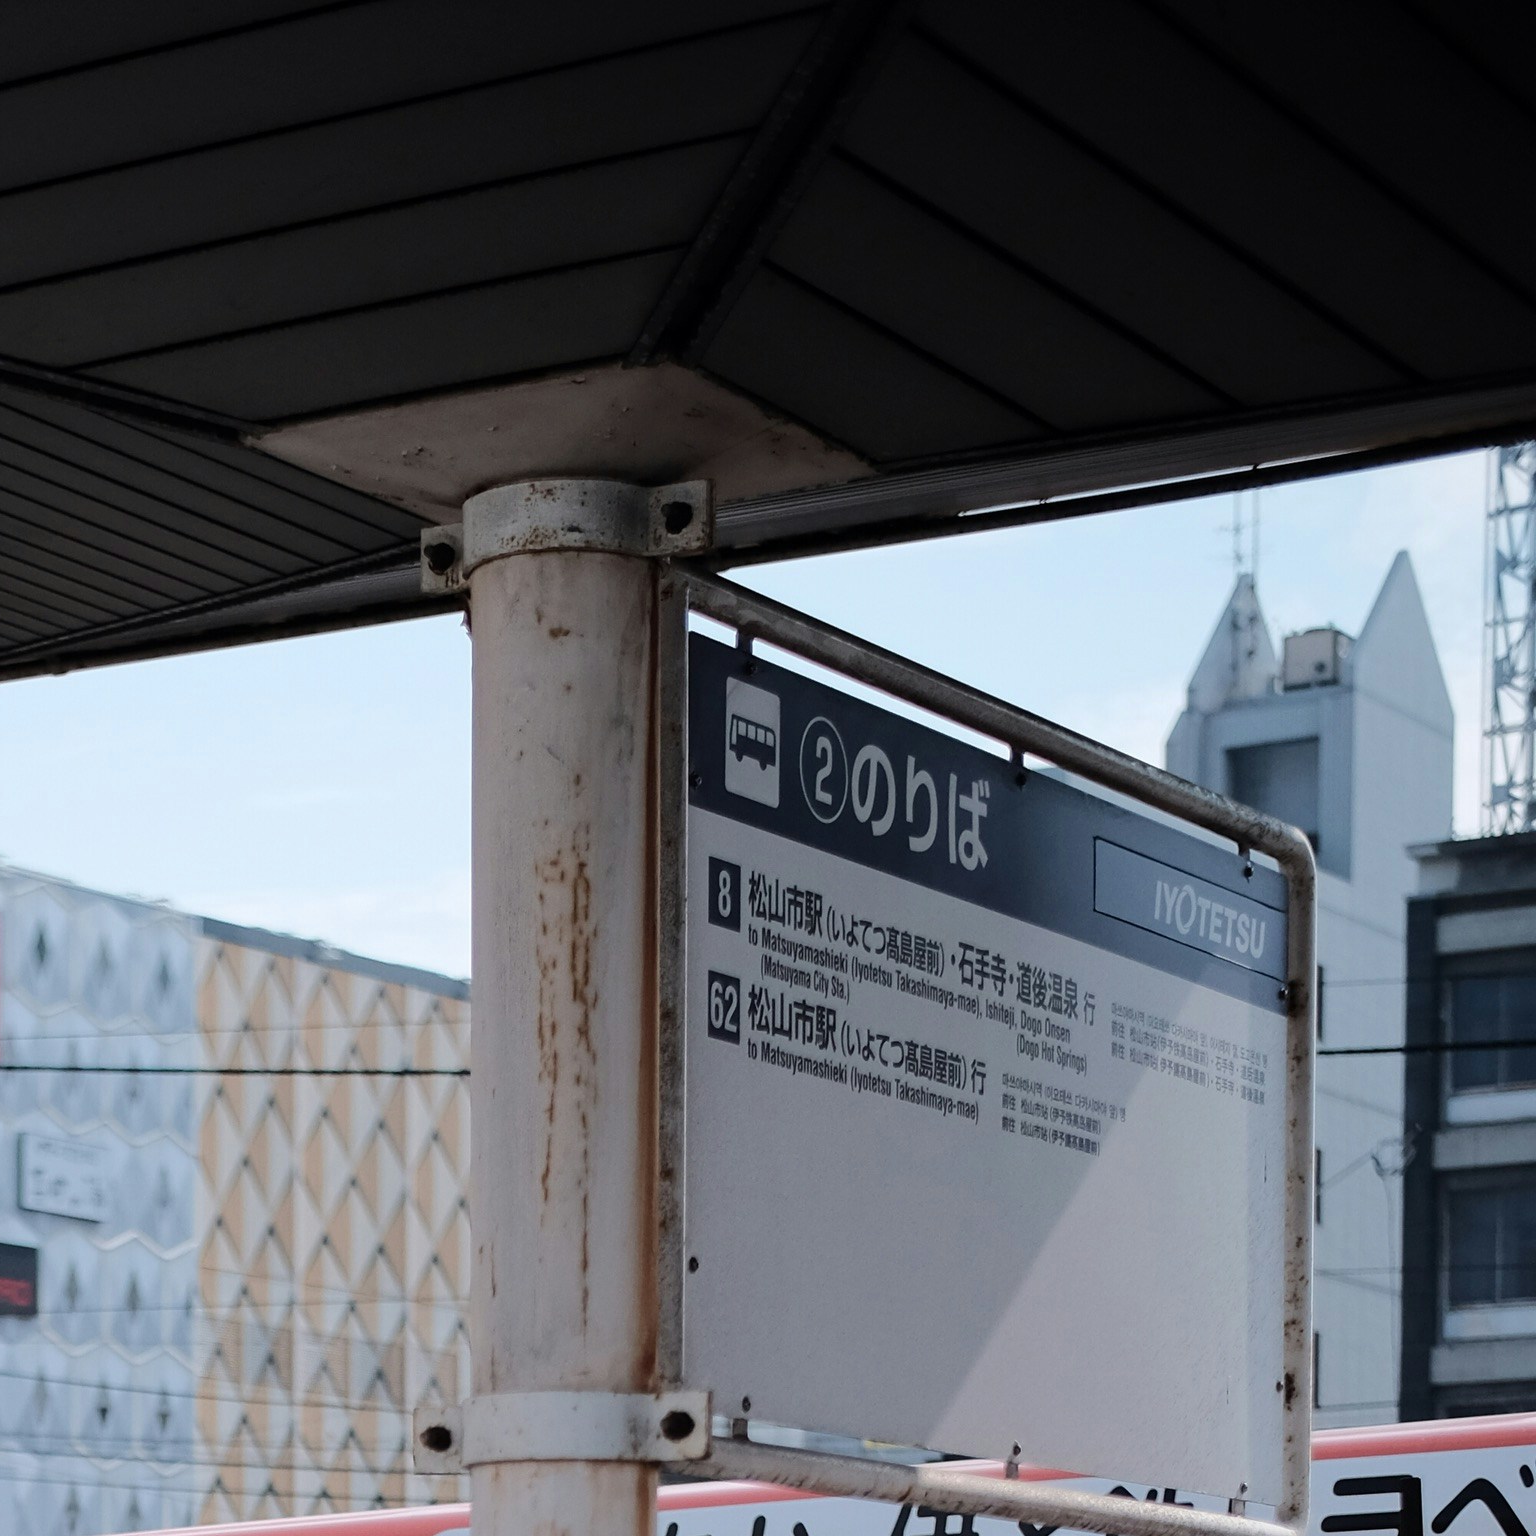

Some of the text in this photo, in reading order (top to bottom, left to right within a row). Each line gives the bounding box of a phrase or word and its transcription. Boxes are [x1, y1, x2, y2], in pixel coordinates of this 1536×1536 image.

[718, 870, 732, 918] 8
[1154, 880, 1265, 959] IYOTETSU
[748, 925, 758, 947] to
[761, 927, 848, 975] Matsuyamashieki
[851, 957, 892, 989] (Iyotetsu
[985, 999, 1017, 1030] Ishiteji,
[1020, 1010, 1042, 1036] Dogo
[1044, 1017, 1070, 1043] Onsen
[760, 953, 850, 1005] (Matsuyama City Sta.)
[709, 980, 738, 1034] 62
[747, 1037, 979, 1126] to Matsuyamashieki (Iyotetsu Takashimaya-mae)
[1016, 1034, 1087, 1076] (Dogo Hot Springs)
